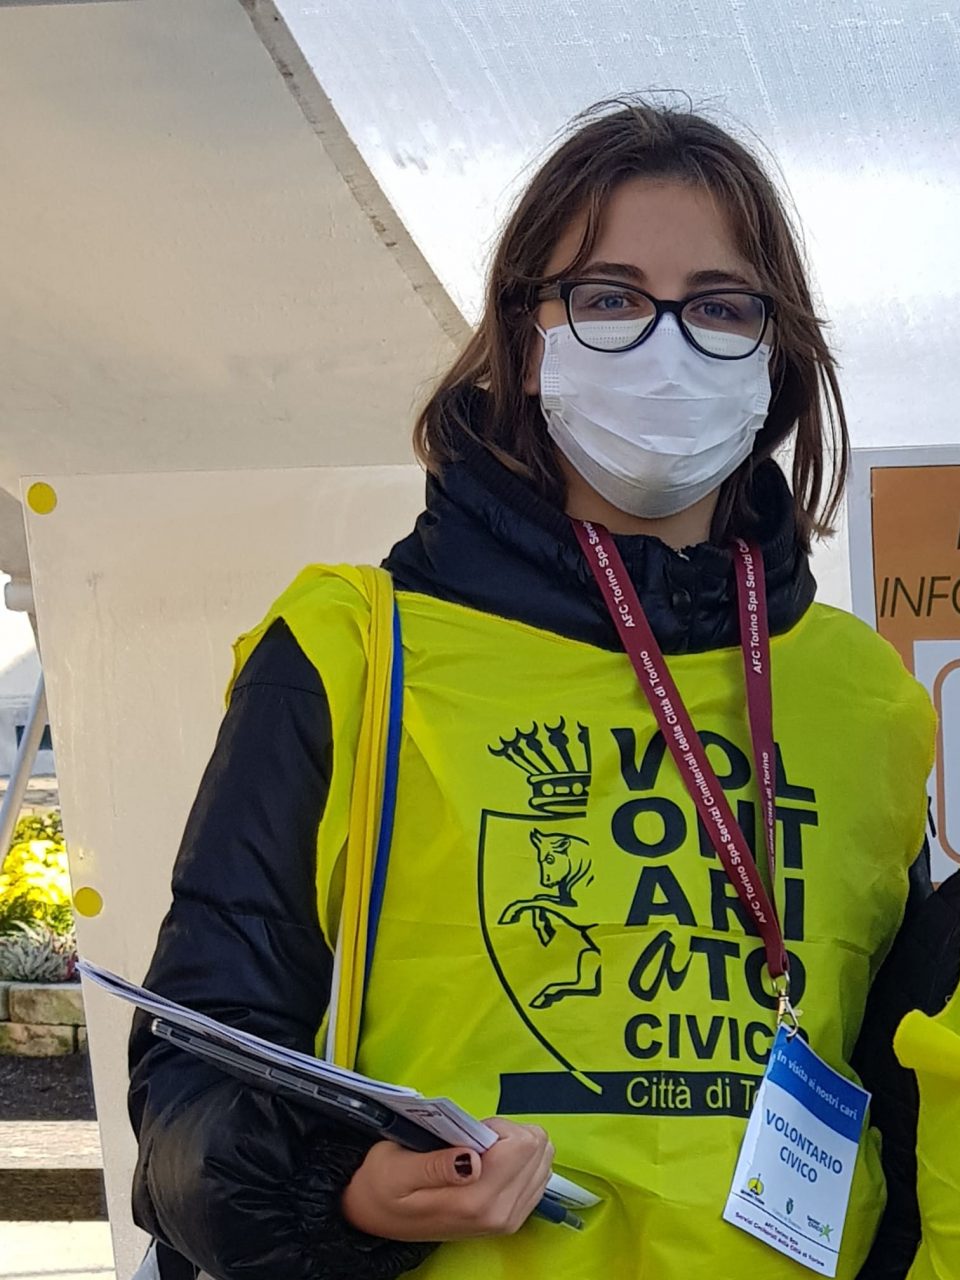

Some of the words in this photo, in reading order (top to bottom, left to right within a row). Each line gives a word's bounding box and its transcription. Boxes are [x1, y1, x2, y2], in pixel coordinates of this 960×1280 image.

[595, 544, 609, 568] Spa
[742, 554, 755, 588] Servizi
[605, 568, 624, 604] Torino
[747, 590, 759, 612] Spa
[618, 604, 635, 627] AFC
[749, 613, 759, 648] Torino
[640, 650, 660, 687] Torino
[751, 650, 762, 674] AFC
[653, 686, 666, 697] di
[660, 697, 677, 724] Città
[673, 724, 690, 751] della
[684, 753, 714, 803] Cimiteriali
[762, 751, 771, 785] Torino
[708, 806, 731, 843] Servizi
[726, 842, 741, 865] Spa
[737, 865, 756, 900] Torino
[625, 865, 805, 941] ARI
[751, 900, 767, 923] AFC
[624, 1013, 809, 1065] CIVIC
[626, 1076, 692, 1110] Città
[706, 1077, 731, 1109] di
[776, 1050, 787, 1067] In
[788, 1059, 808, 1082] visita
[808, 1078, 816, 1090] ai
[815, 1085, 839, 1108] nostri
[839, 1104, 858, 1120] cari
[766, 1108, 843, 1174] VOLONTARIO
[779, 1146, 818, 1183] CIVICO
